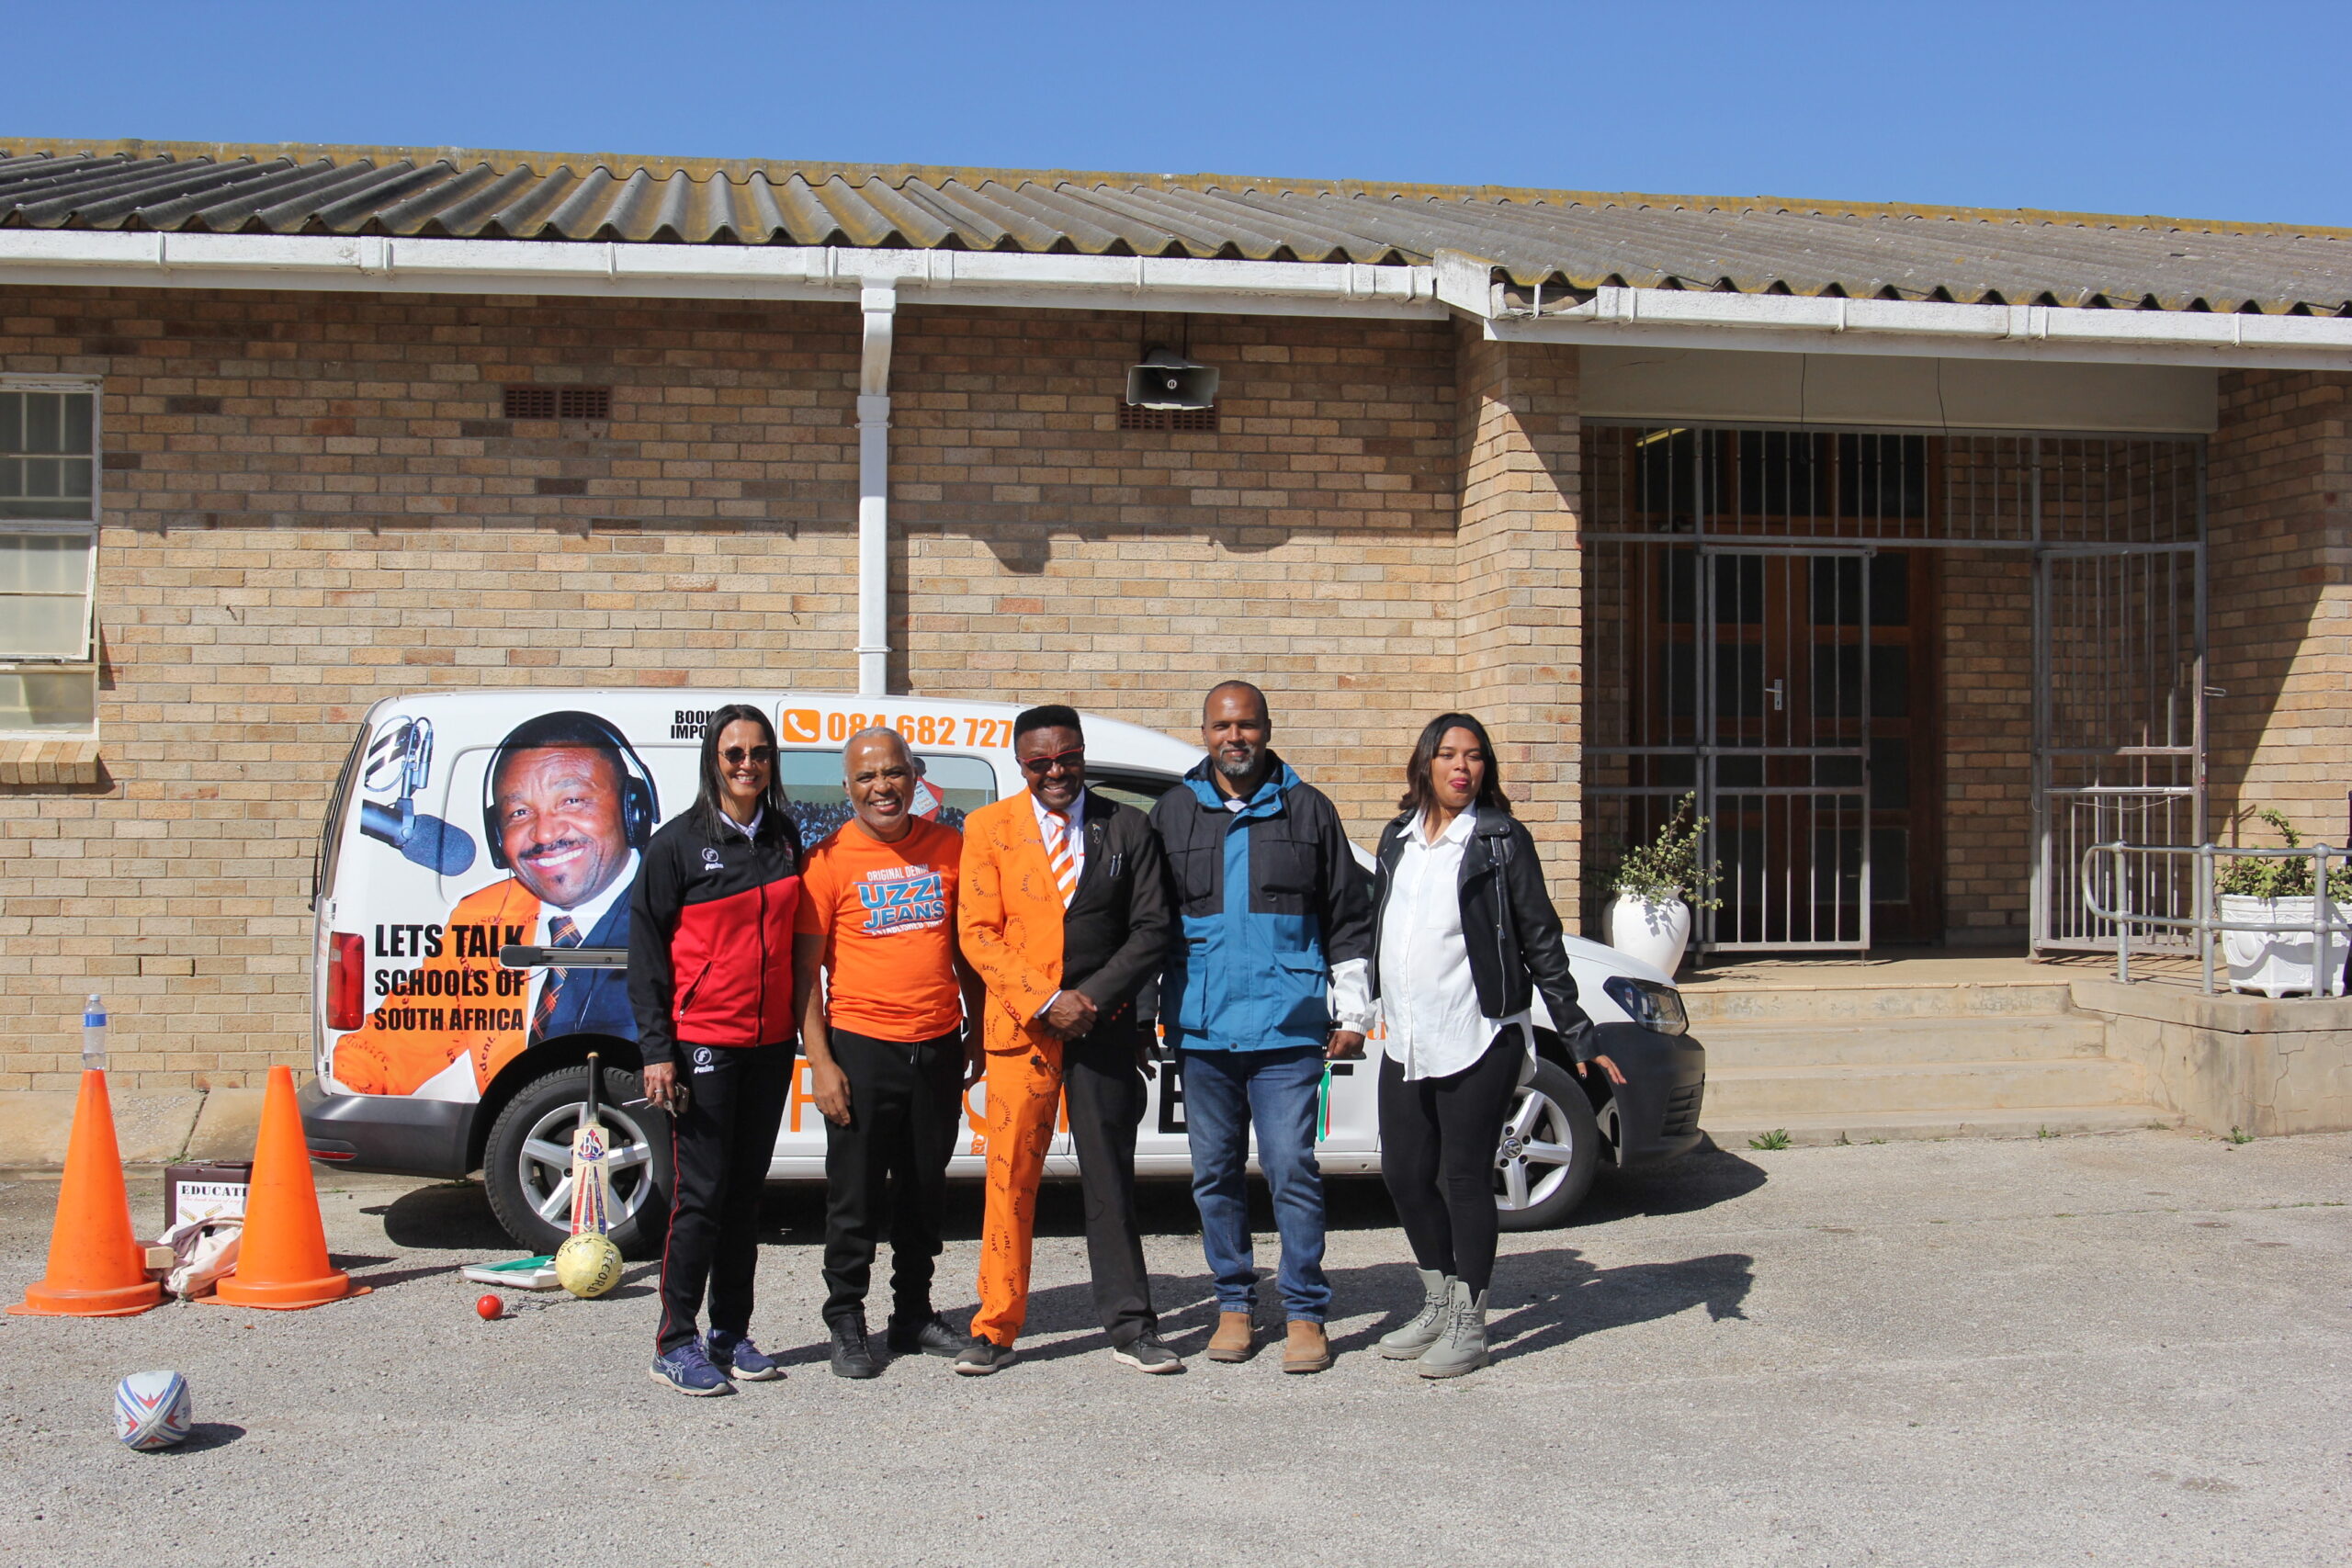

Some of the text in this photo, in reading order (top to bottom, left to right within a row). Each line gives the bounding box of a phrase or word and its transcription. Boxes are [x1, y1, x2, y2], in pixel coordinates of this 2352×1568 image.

[896, 715, 956, 746] 682
[963, 717, 1013, 749] 727
[866, 863, 930, 882] ORIGINAL DENIM
[858, 874, 944, 909] UZZI
[864, 900, 946, 929] JEANS
[375, 924, 526, 958] LETS TALK
[375, 969, 489, 997] SCHOOLS
[496, 970, 525, 997] OF
[374, 1008, 524, 1031] SOUTH AFRICA
